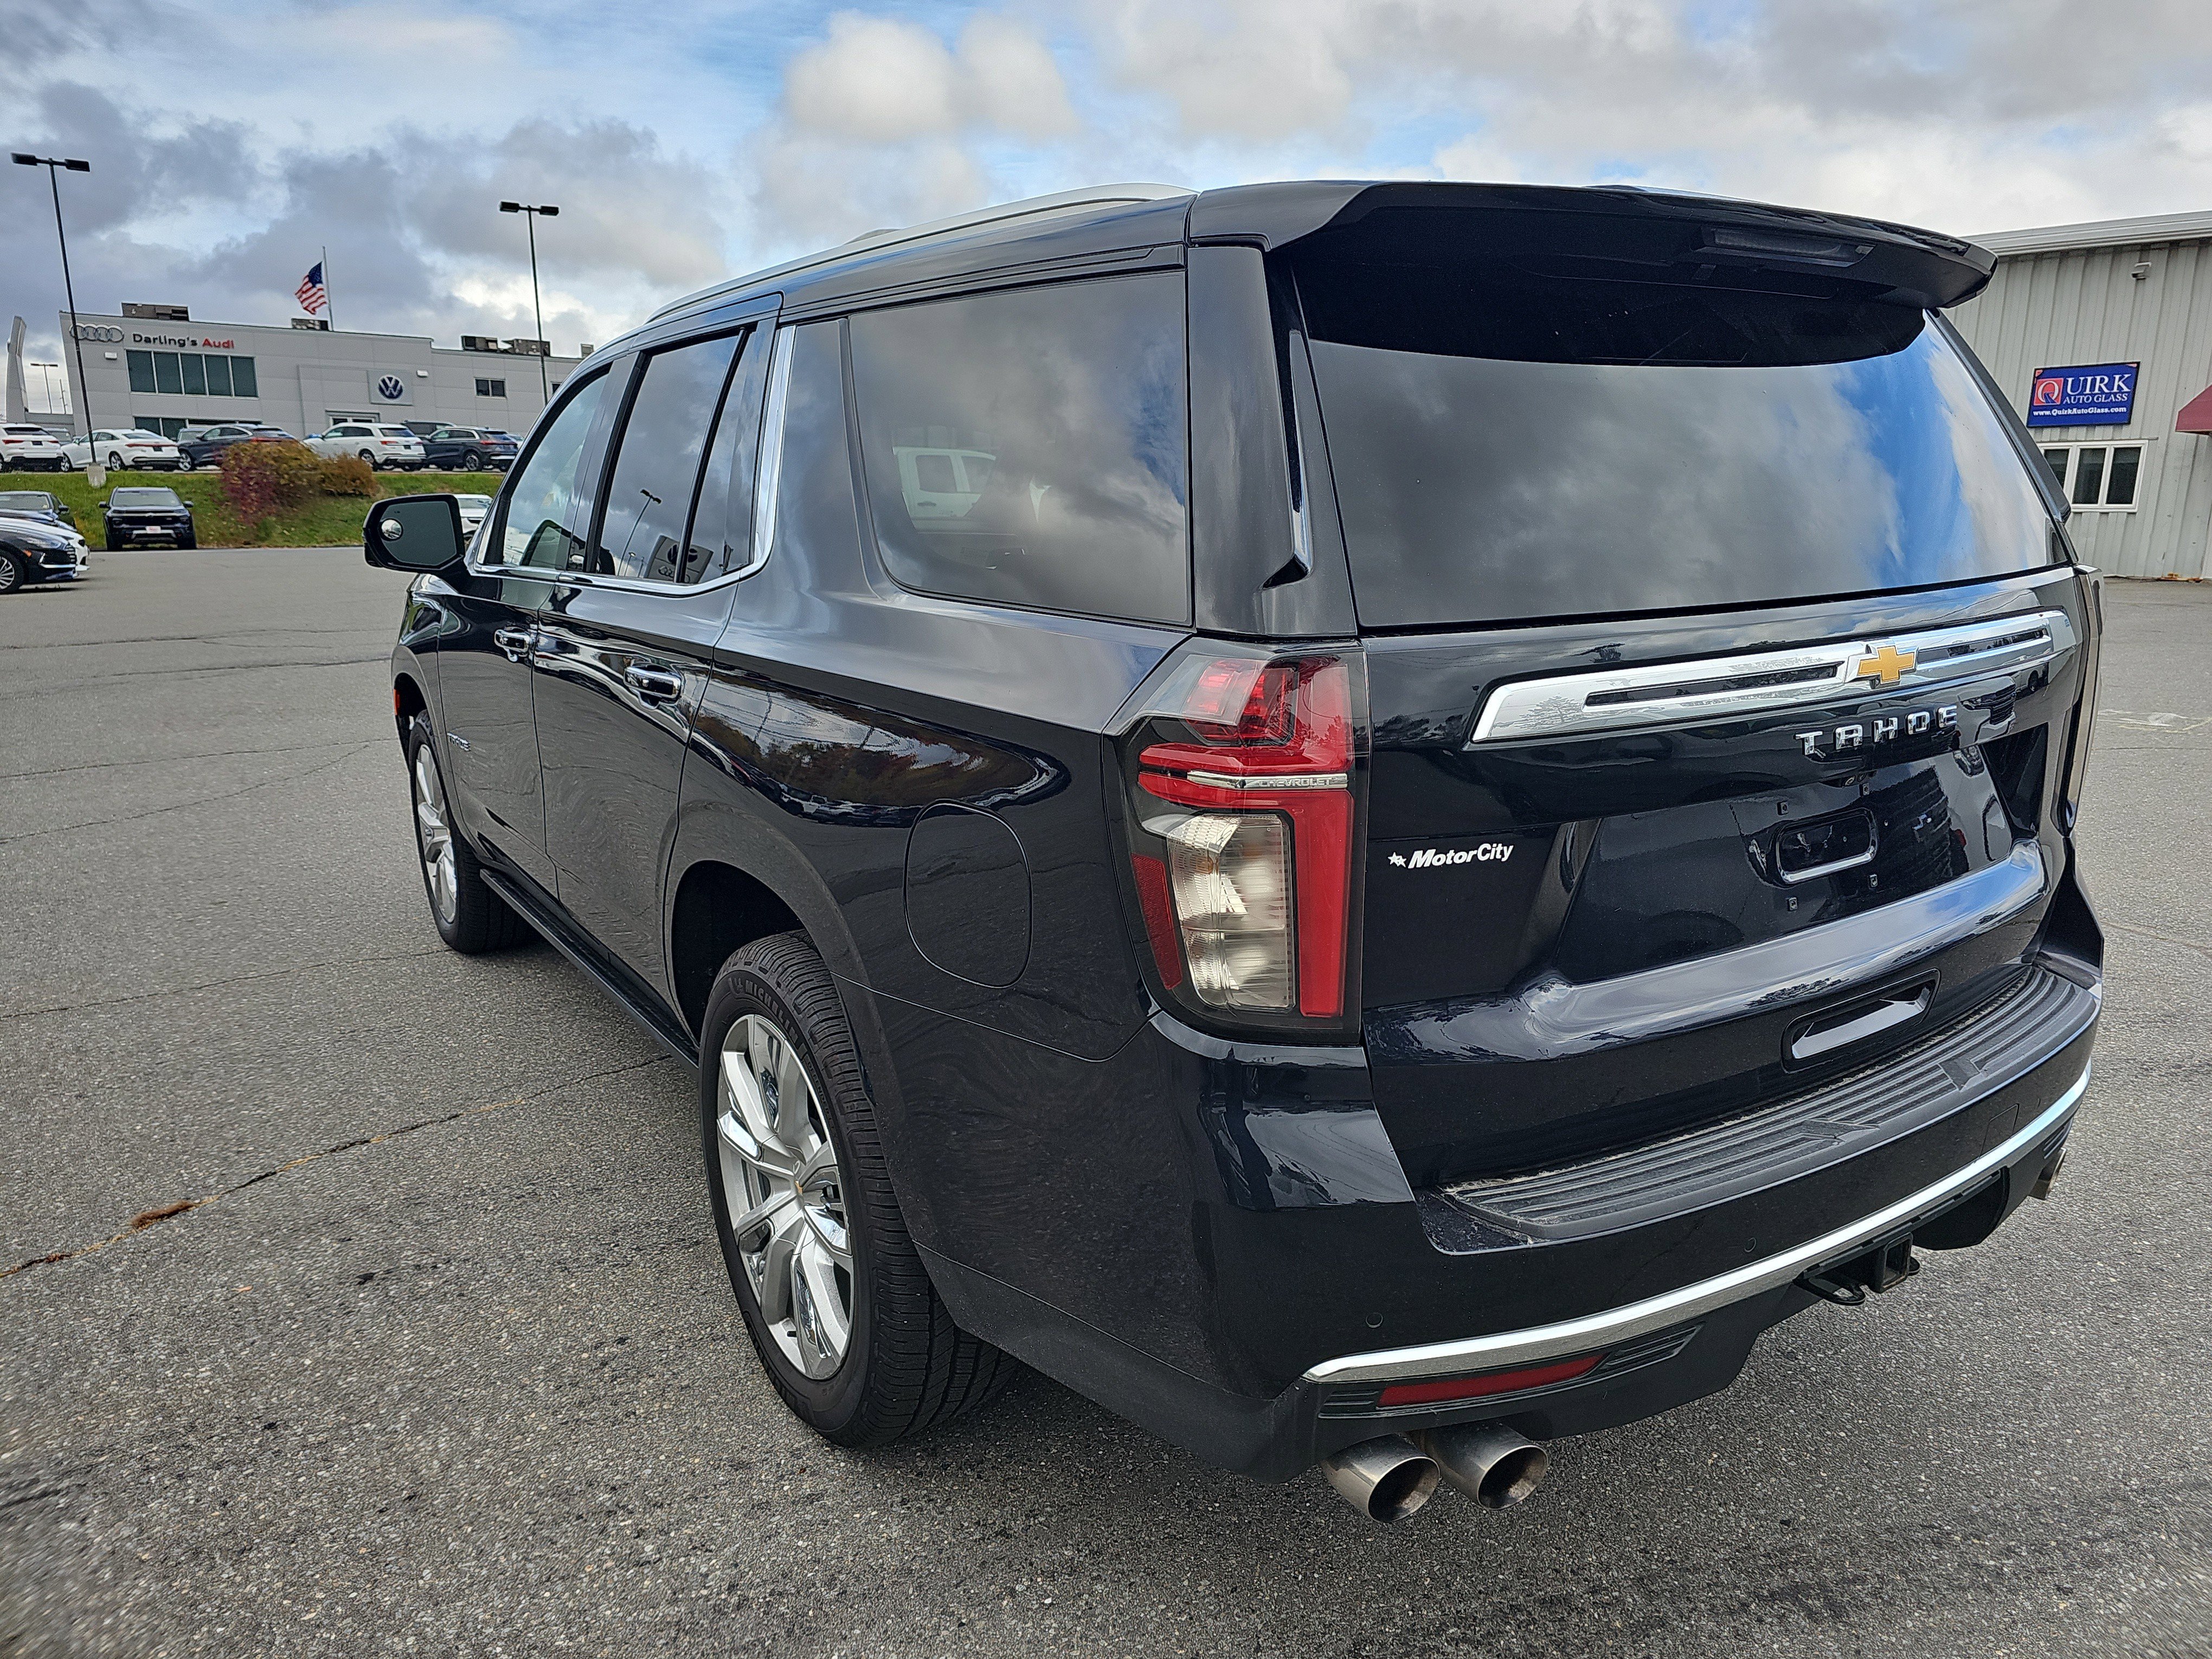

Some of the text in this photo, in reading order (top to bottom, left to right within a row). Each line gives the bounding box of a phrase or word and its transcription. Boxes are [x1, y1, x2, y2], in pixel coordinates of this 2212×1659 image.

[132, 333, 235, 349] Darling's Audi
[2037, 374, 2132, 404] QUIRK
[2063, 393, 2128, 404] AUTO GLASS
[2033, 407, 2127, 416] www.QuirkAutoGlass.com
[1793, 705, 1957, 756] TAHOE
[1259, 778, 1331, 787] CHEVROLET
[1408, 843, 1514, 869] MotorCity
[745, 979, 798, 1044] MICHELIN
